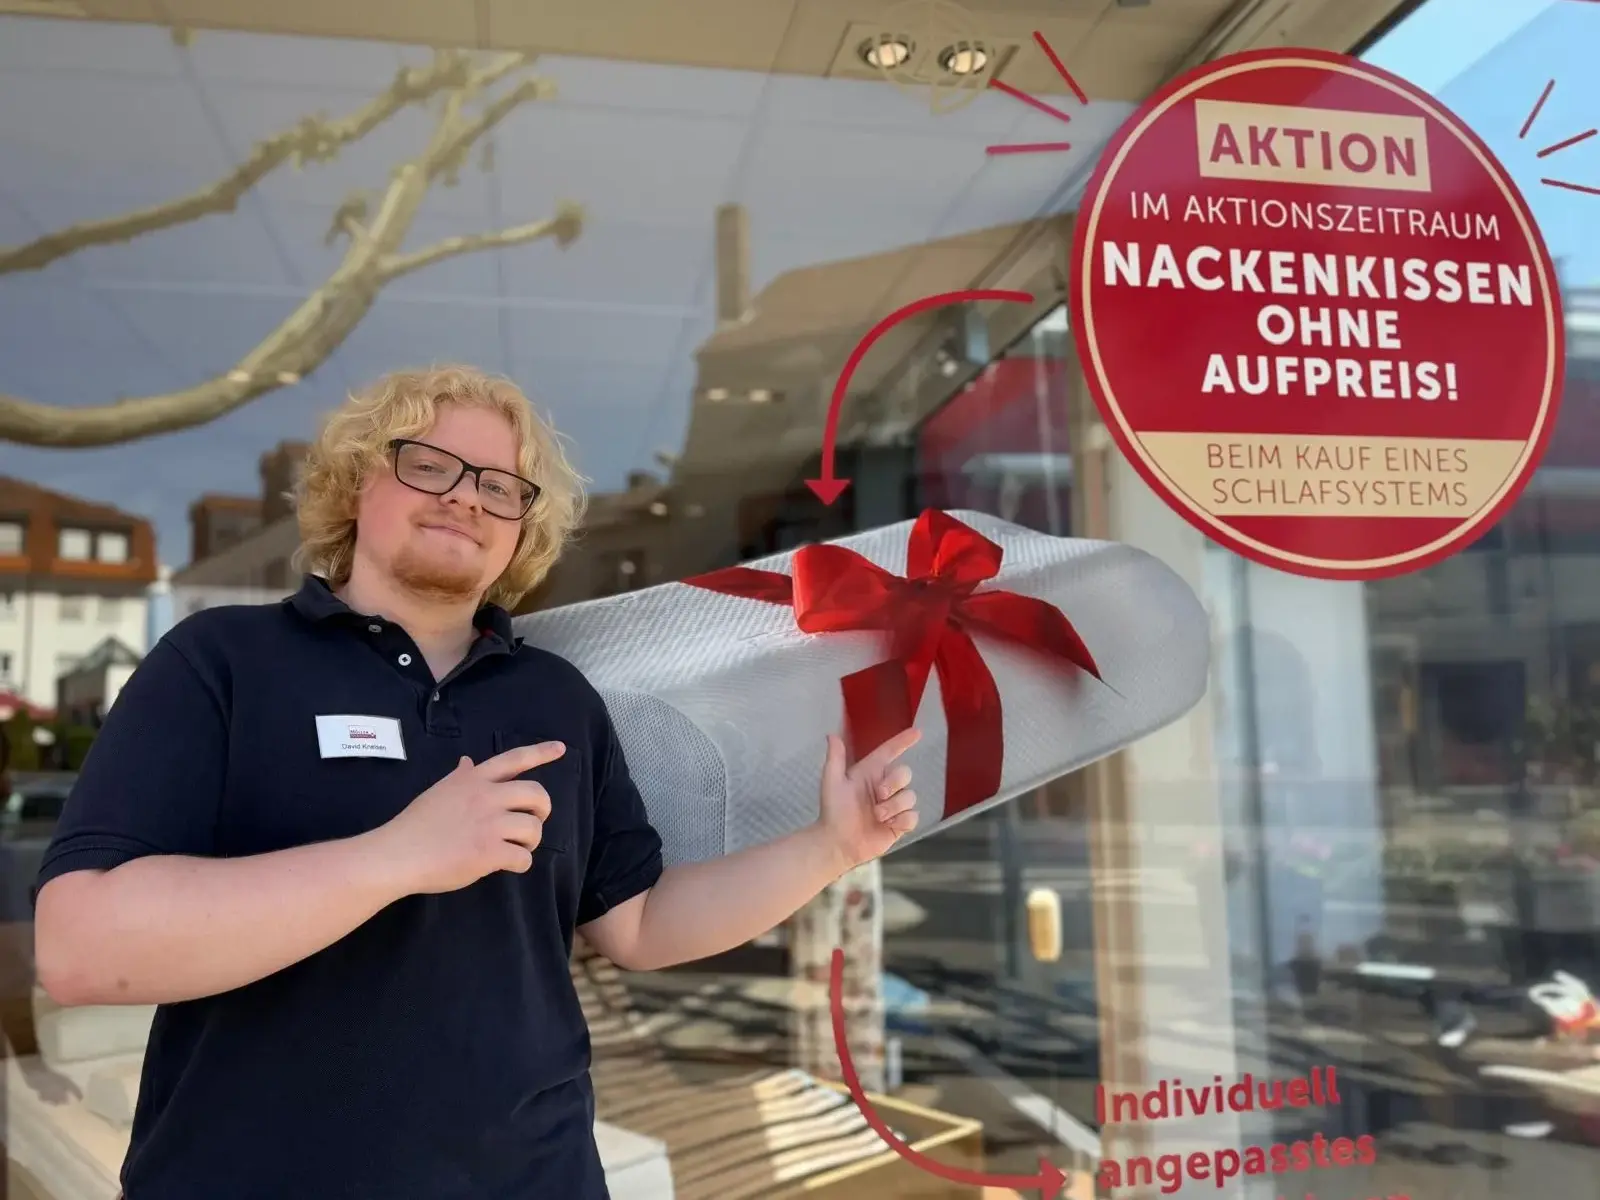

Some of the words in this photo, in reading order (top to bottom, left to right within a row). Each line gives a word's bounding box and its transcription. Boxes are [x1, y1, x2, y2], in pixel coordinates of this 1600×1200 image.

[1208, 121, 1418, 178] AKTION
[1130, 191, 1170, 221] IM
[1183, 194, 1501, 242] AKTIONSZEITRAUM
[1101, 240, 1534, 307] NACKENKISSEN
[1256, 304, 1402, 349] OHNE
[1201, 353, 1459, 401] AUFPREIS!
[1207, 443, 1283, 471] BEIM
[1295, 444, 1373, 472] KAUF
[1385, 446, 1469, 474] EINES
[1212, 478, 1469, 507] SCHLAFSYSTEMS
[1094, 1065, 1341, 1125] Individuell
[1097, 1132, 1377, 1194] angepasstes
